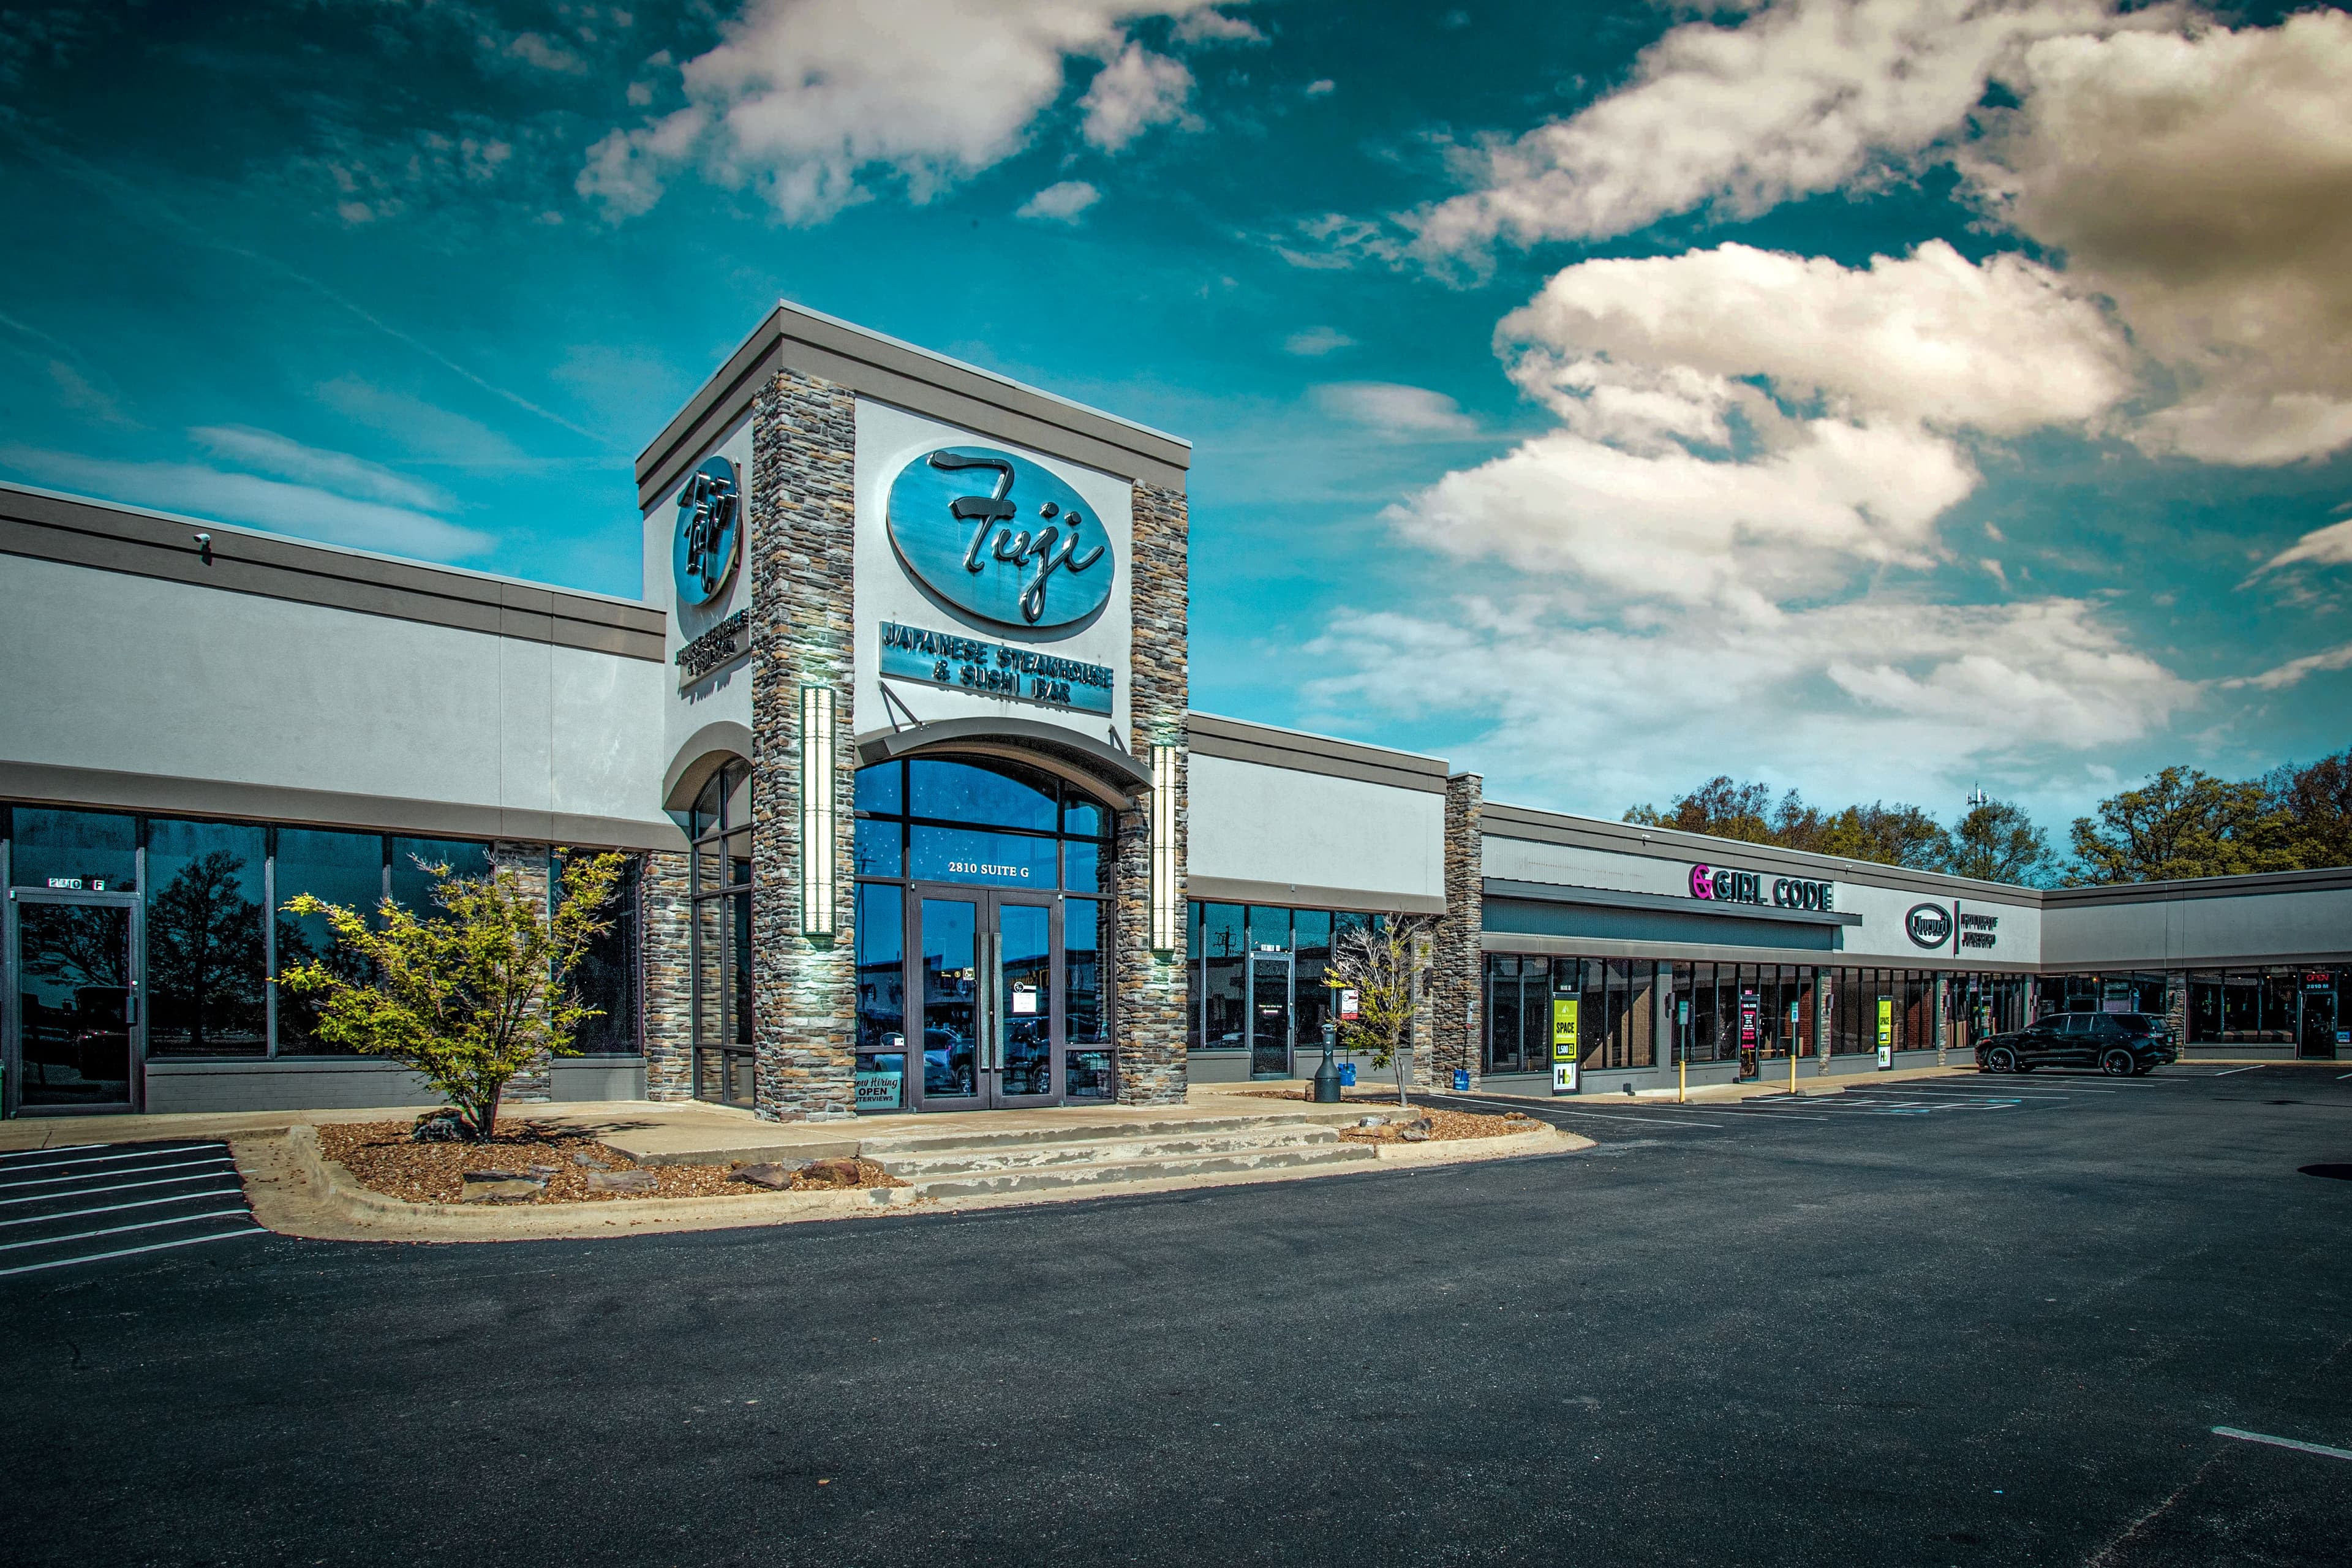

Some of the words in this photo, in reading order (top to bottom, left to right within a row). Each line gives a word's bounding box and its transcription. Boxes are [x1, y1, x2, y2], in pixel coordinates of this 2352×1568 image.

[927, 451, 1105, 623] Fuji
[883, 624, 989, 664] JAPANESE
[997, 647, 1114, 688] STEAKHOUSE
[933, 659, 951, 680] &
[959, 665, 1020, 693] SUSHI
[1033, 677, 1071, 703] BAR
[949, 861, 977, 873] 2810
[981, 864, 1017, 876] SUITE
[1020, 867, 1029, 878] G
[1713, 870, 1768, 904] GIRL
[1773, 877, 1833, 911] CODE
[1556, 1022, 1574, 1033] SPACE
[871, 1077, 898, 1088] Hiring
